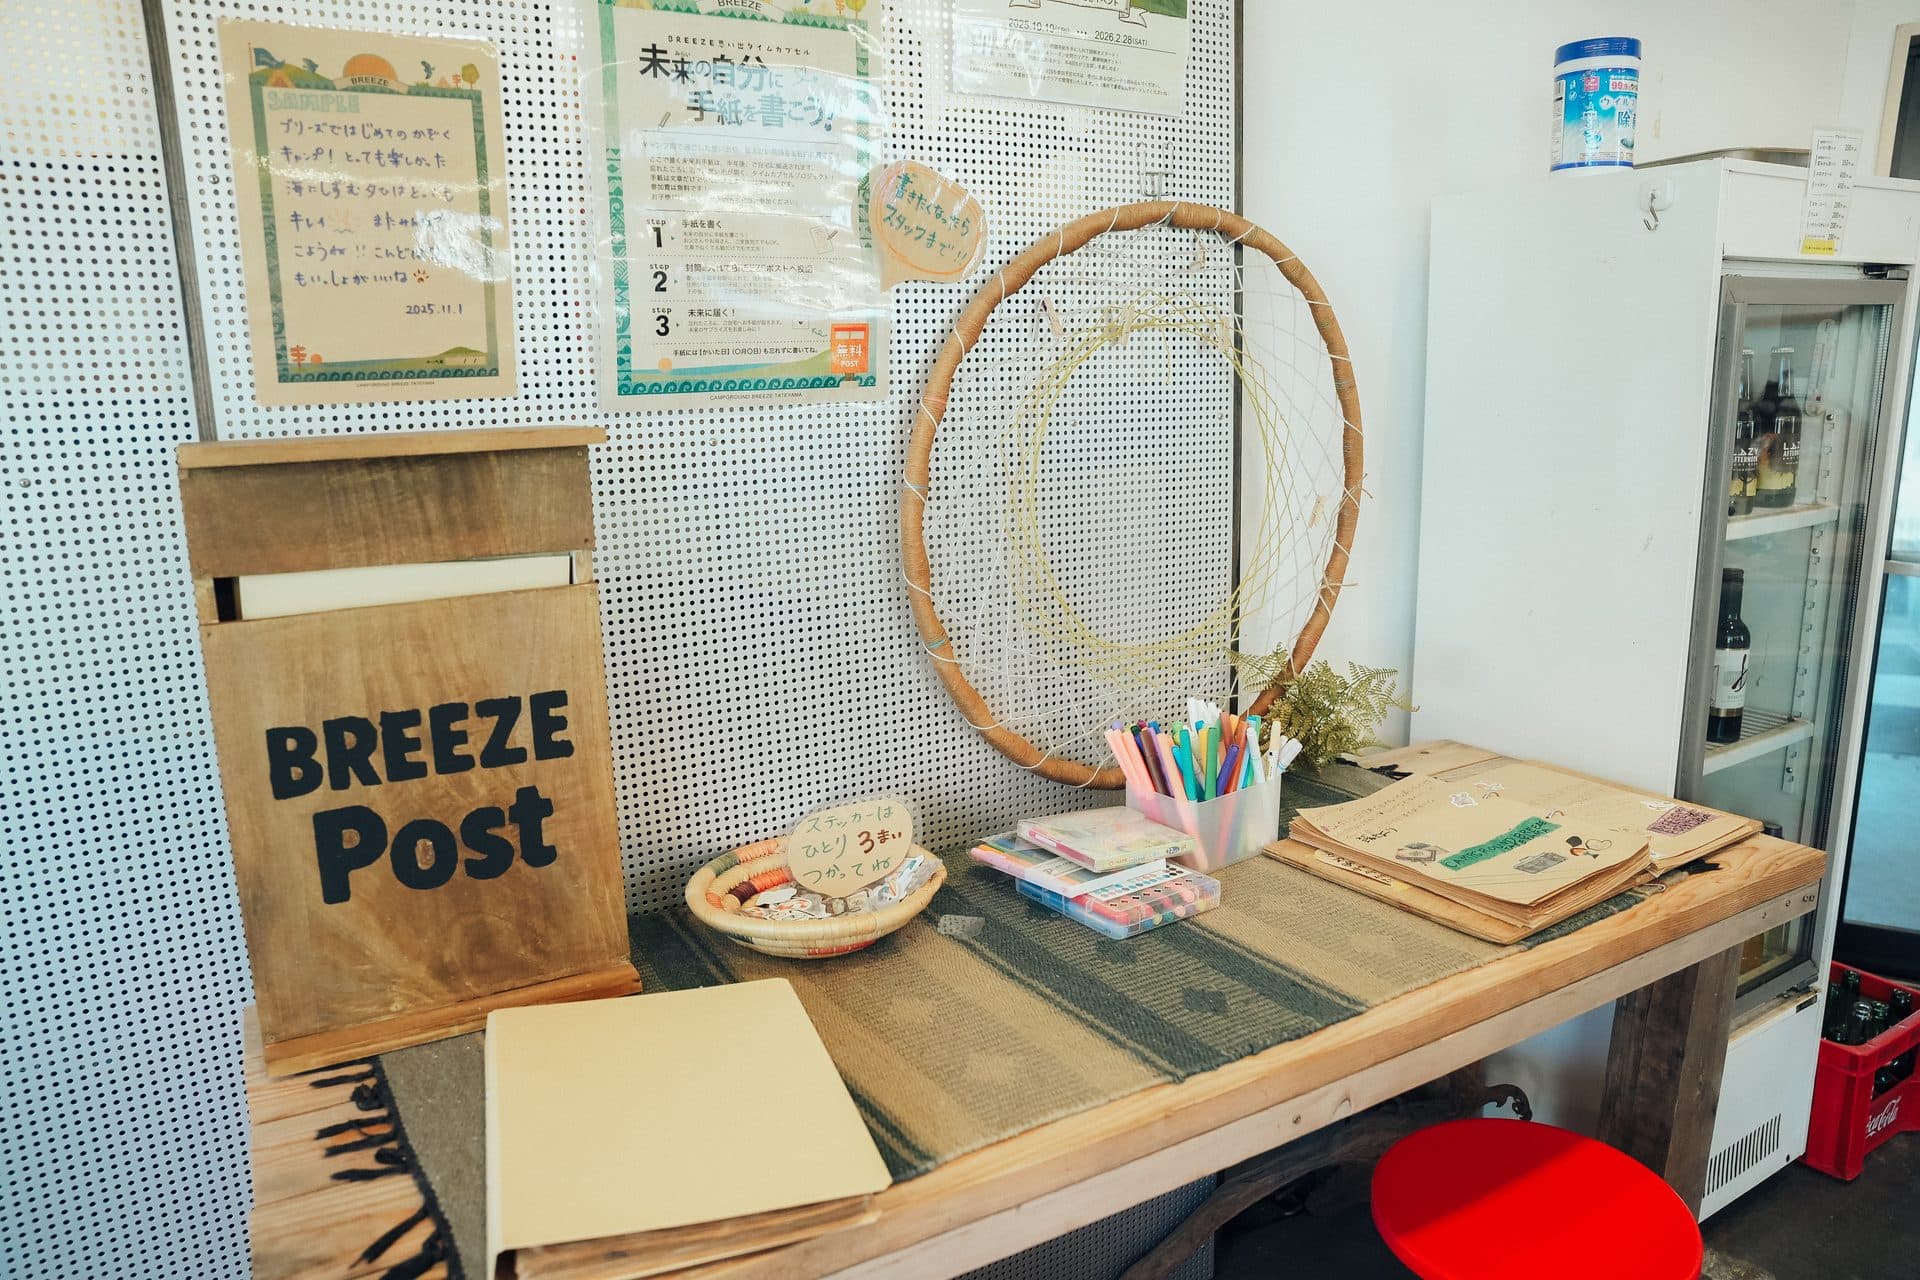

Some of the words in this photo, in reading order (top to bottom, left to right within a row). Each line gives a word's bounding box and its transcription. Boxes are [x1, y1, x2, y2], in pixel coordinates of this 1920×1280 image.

[717, 0, 763, 11] BREEZE
[639, 43, 785, 92] 未来の自分に
[350, 76, 389, 87] BREEZE
[268, 91, 361, 113] SAMPLE
[682, 219, 723, 229] 手紙を書く
[652, 226, 663, 248] 1
[653, 270, 668, 293] 2
[404, 303, 463, 315] 2025.11.1
[652, 307, 672, 315] step
[688, 309, 736, 318] 未来に届く！
[655, 315, 670, 337] 3
[265, 690, 575, 800] BREEZE
[806, 805, 895, 834] ステッカーは
[802, 856, 892, 885] つかってね
